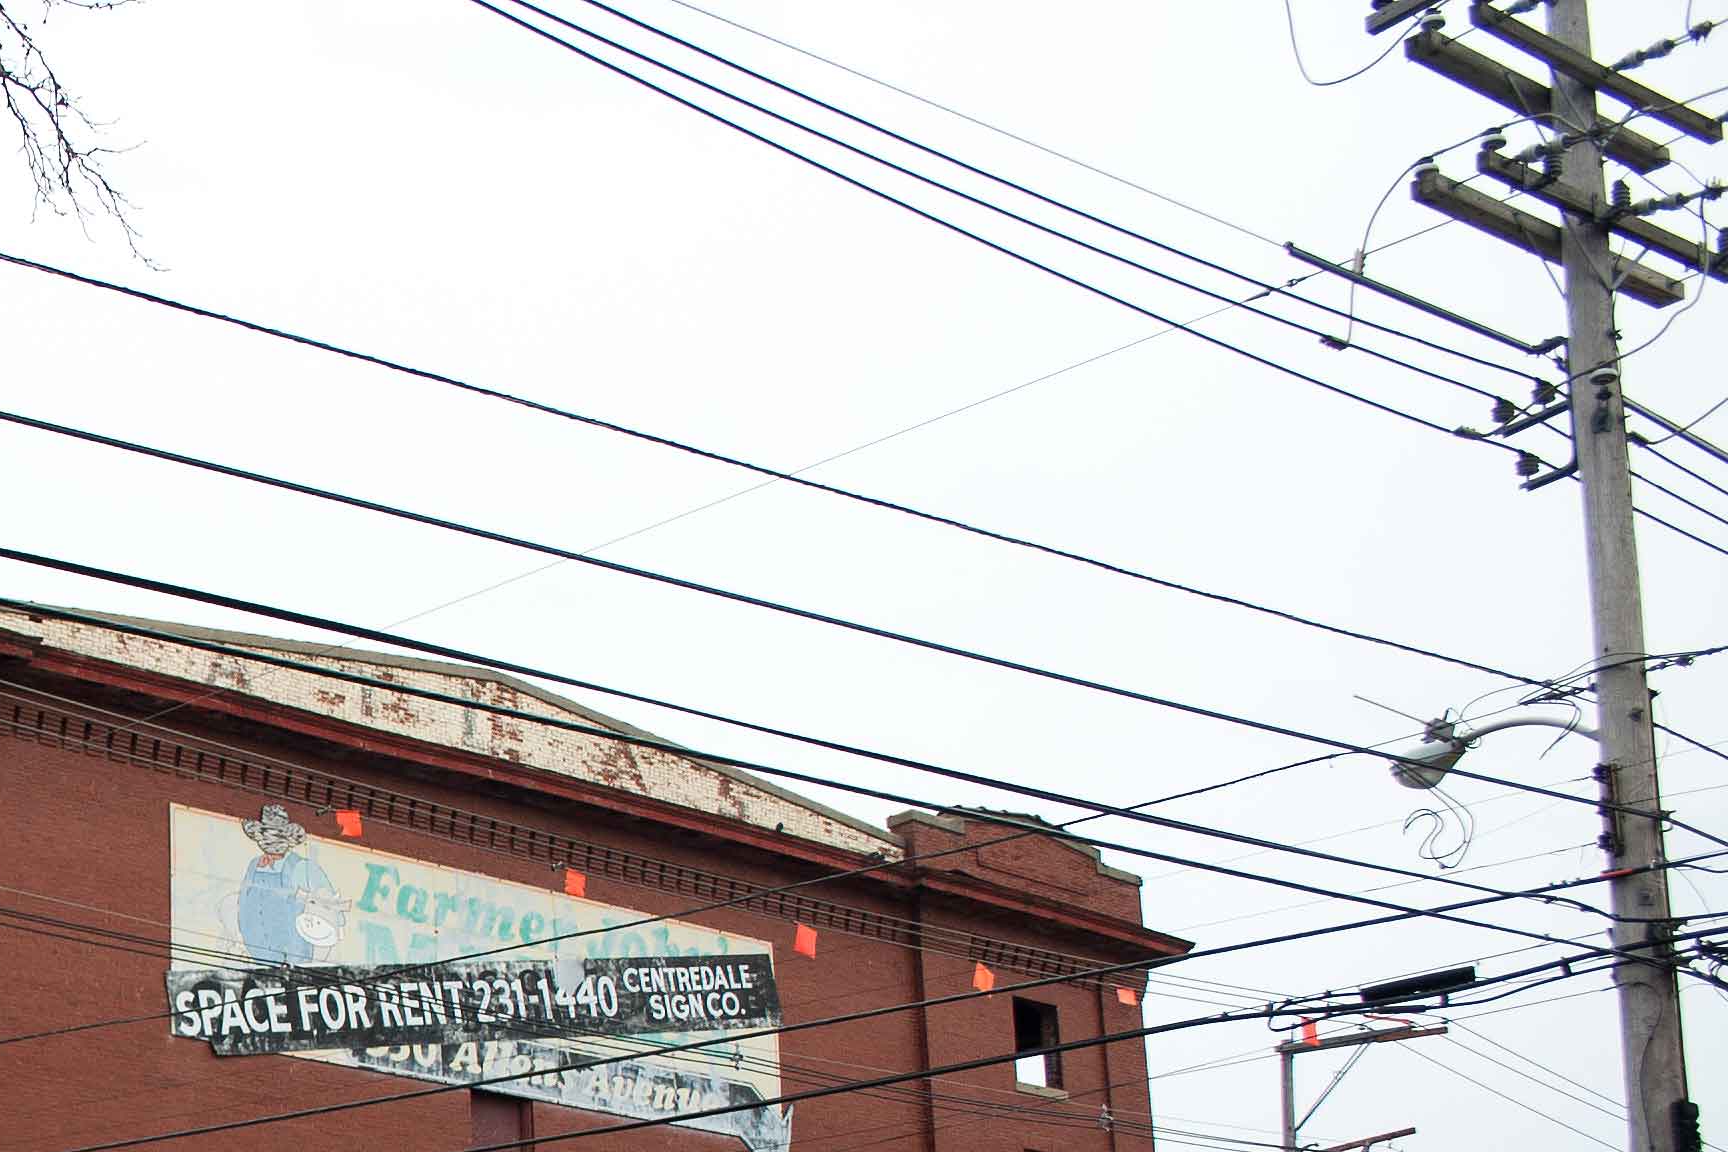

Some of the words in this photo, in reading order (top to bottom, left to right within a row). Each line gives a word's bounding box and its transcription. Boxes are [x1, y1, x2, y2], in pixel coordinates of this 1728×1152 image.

[622, 964, 753, 993] CENTREDALE
[175, 987, 292, 1036] SPACE
[297, 984, 372, 1032] FOR
[378, 980, 464, 1028] RENT
[472, 974, 620, 1024] 231-1440
[648, 993, 705, 1021] SIGN
[706, 992, 746, 1019] CO.
